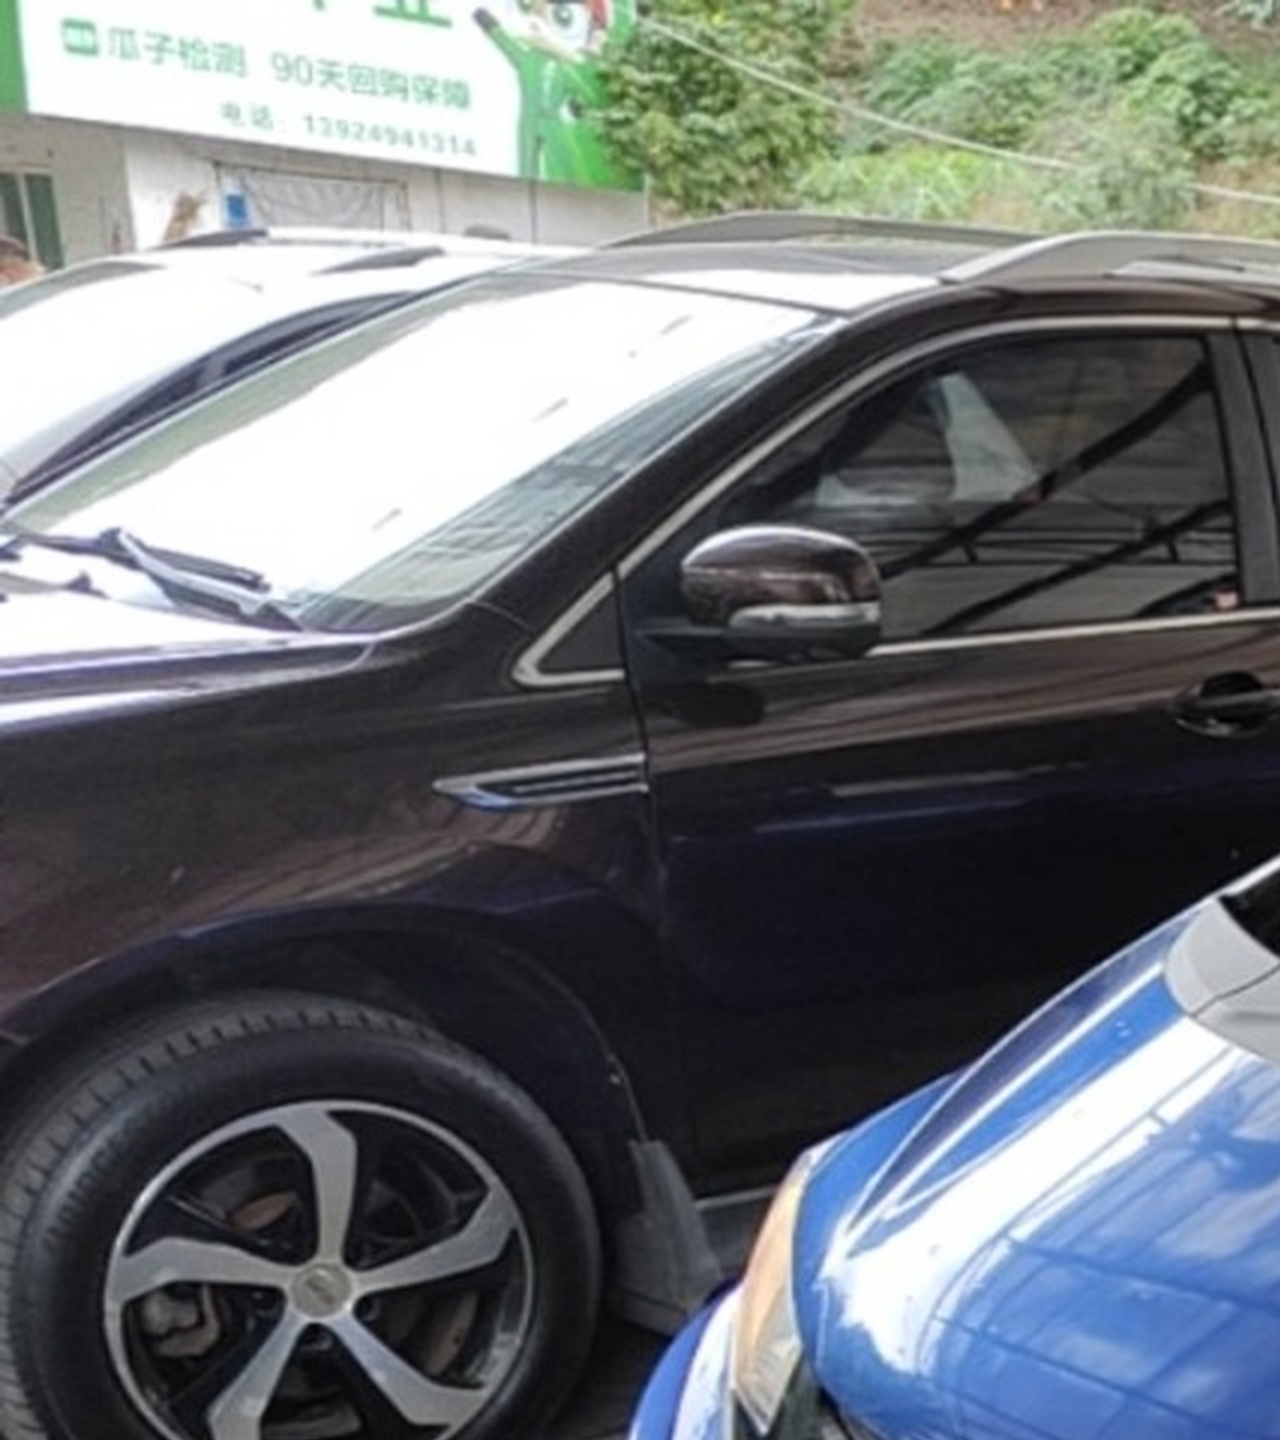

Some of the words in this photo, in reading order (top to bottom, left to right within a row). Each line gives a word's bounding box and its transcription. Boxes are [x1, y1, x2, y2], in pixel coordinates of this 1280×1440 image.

[107, 26, 247, 79] 瓜子检测
[270, 51, 471, 110] 90天回购保障
